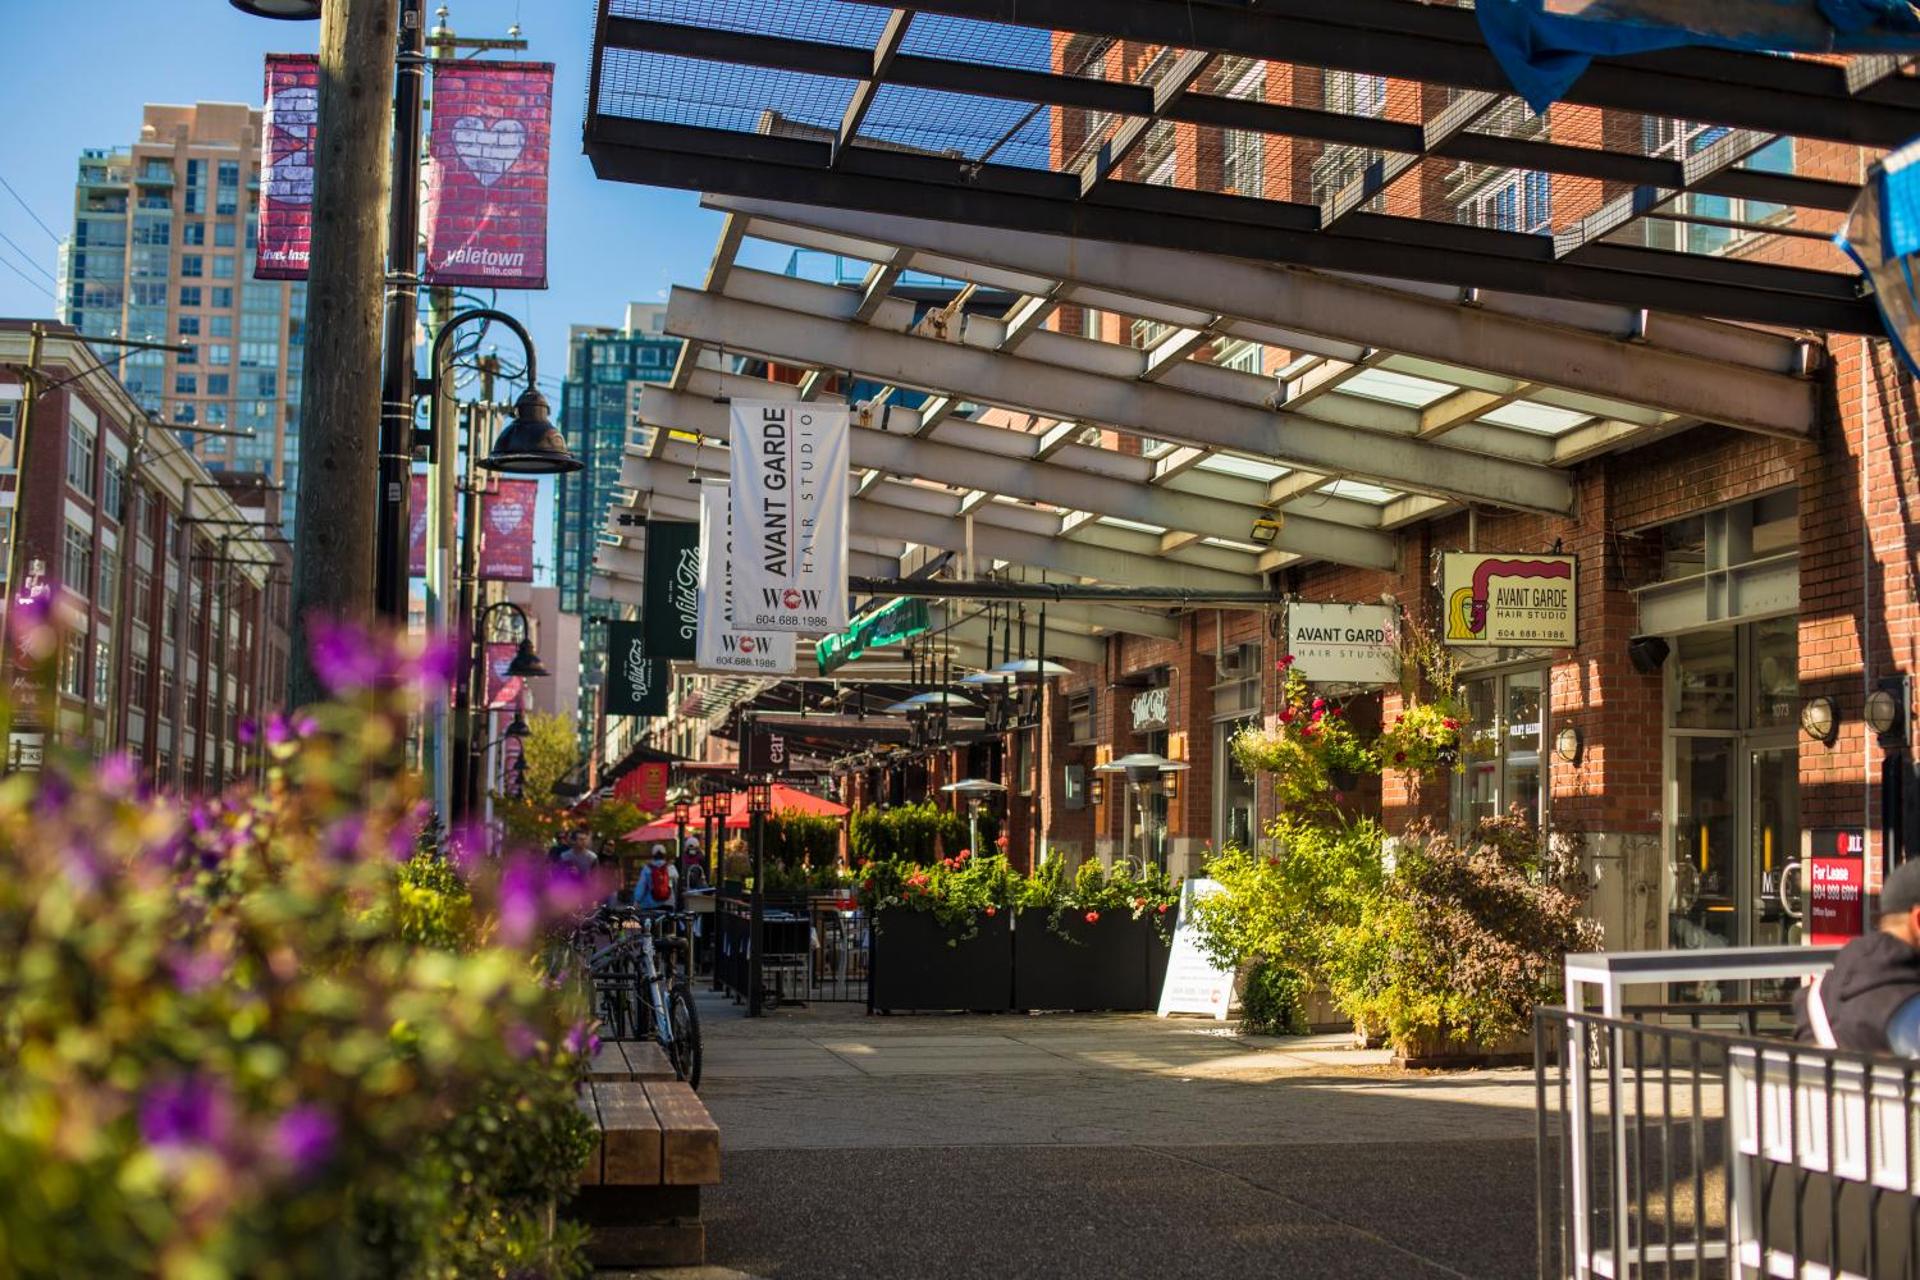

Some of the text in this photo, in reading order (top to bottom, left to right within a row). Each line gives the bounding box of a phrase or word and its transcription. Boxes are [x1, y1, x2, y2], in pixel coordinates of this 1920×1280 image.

[446, 247, 524, 267] yaletown
[483, 266, 522, 276] info.com
[763, 407, 787, 577] AVANT GARDE
[800, 413, 814, 574] HAIR STUDIO
[763, 587, 822, 611] WOW
[1496, 587, 1568, 608] AVANT GARDE
[756, 613, 828, 627] 604.688.1986
[1497, 611, 1567, 620] HAIR STUDIO
[721, 633, 772, 654] WOW
[1296, 627, 1393, 644] AVANT GARD
[1298, 648, 1331, 657] HAIR
[715, 655, 777, 669] 604.688.1986
[1813, 863, 1849, 881] For Lease
